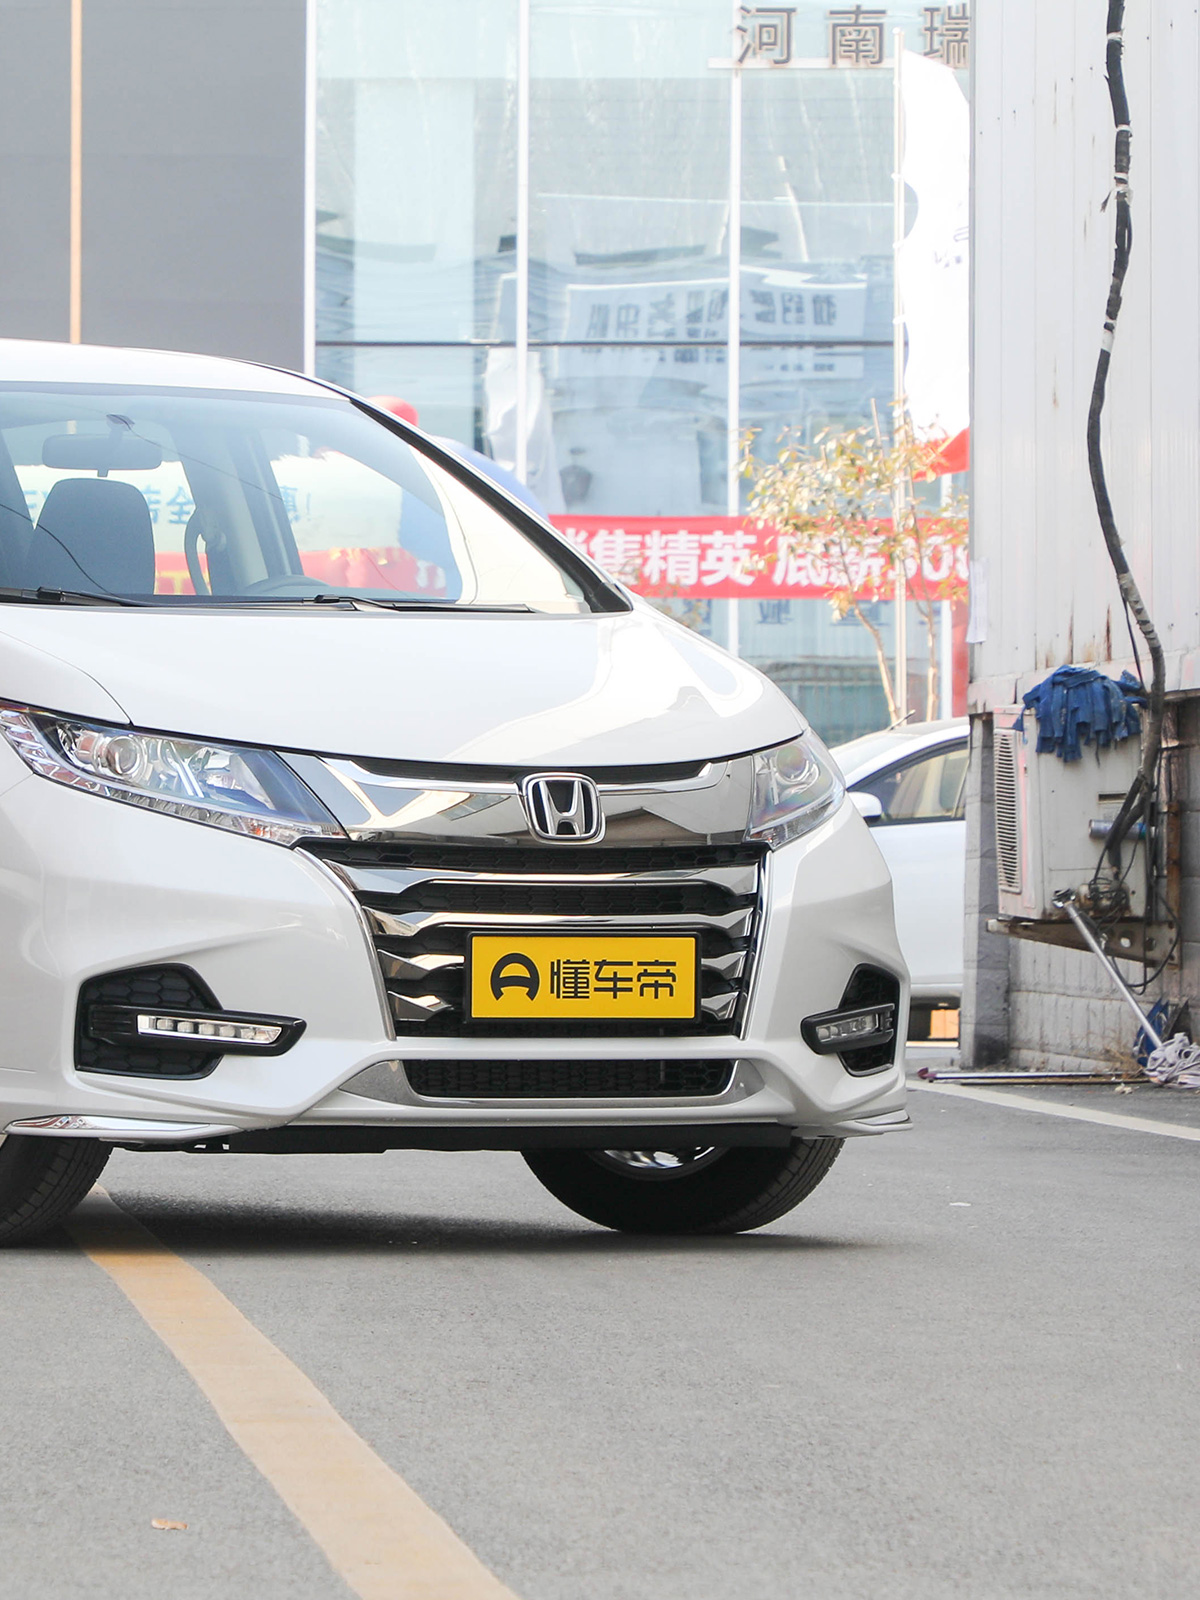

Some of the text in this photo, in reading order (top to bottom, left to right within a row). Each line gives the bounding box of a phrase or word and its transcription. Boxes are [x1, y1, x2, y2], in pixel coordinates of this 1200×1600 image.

[735, 3, 970, 67] 河南瑞
[550, 959, 677, 999] 懂车帝
